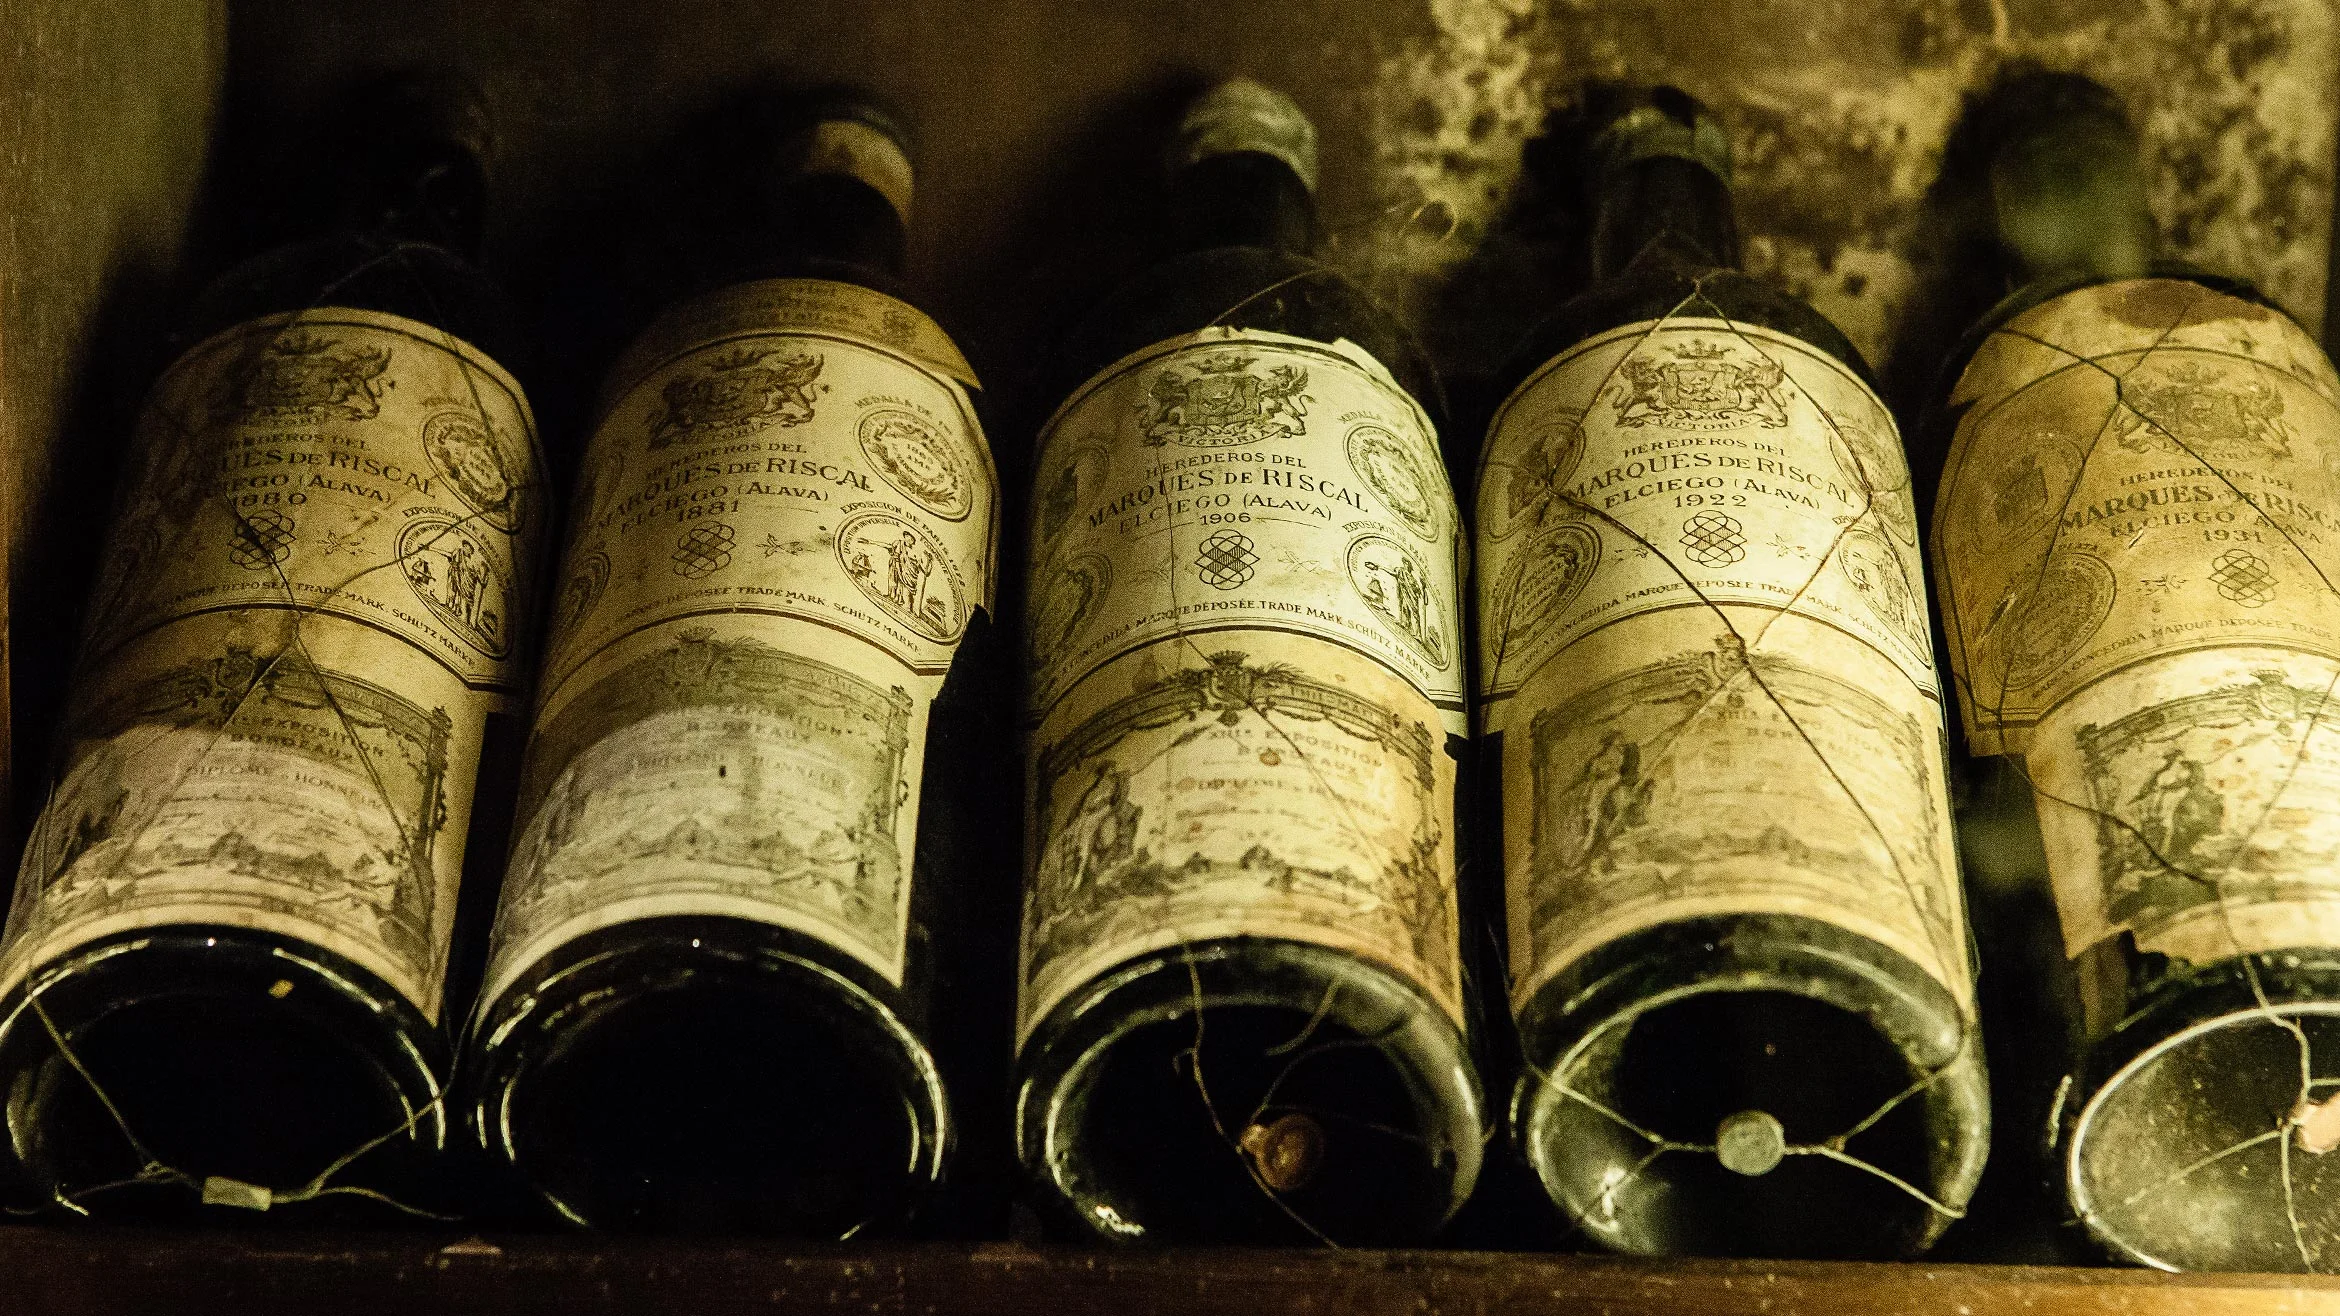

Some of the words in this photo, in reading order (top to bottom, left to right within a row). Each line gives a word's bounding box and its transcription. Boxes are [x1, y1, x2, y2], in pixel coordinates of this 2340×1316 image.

[767, 443, 808, 454] DEL
[1624, 437, 1748, 459] HEREDEROS
[289, 451, 324, 465] DE
[329, 451, 436, 499] RISCAL
[728, 462, 760, 475] DE
[767, 457, 873, 493] RISCAL
[1146, 452, 1266, 479] HEREDEROS
[1271, 454, 1307, 469] DEL
[737, 480, 829, 502] (ALAVA)
[1224, 471, 1253, 485] DE
[1262, 468, 1369, 512] RISCAL
[1604, 475, 1725, 510] ELCIEGO
[1734, 477, 1820, 509] (ALAVA)
[1718, 455, 1751, 469] DE
[1757, 456, 1854, 508] RISCAL
[678, 500, 739, 522] 1881
[1242, 492, 1332, 521] (ALAVA)
[1675, 493, 1747, 508] 1922
[1200, 512, 1251, 525] 1906
[1626, 581, 1685, 600] MARQUE
[1259, 600, 1302, 614] TRADE
